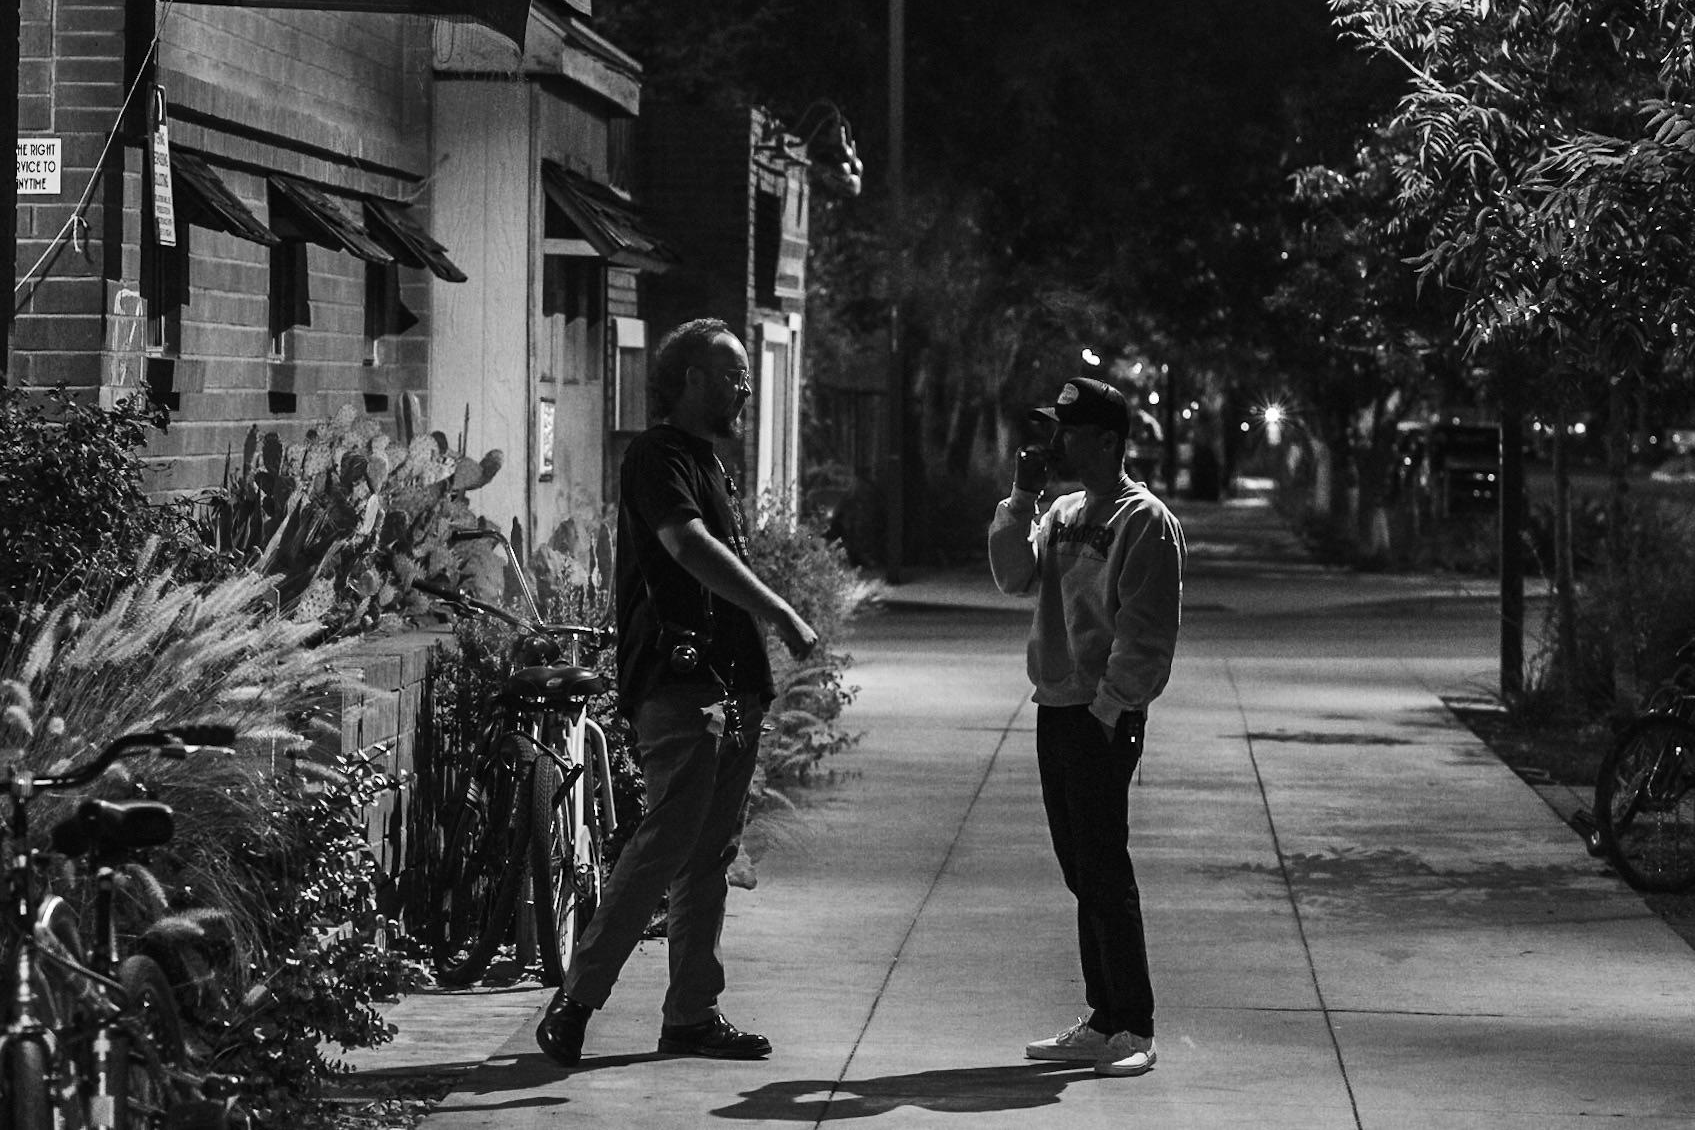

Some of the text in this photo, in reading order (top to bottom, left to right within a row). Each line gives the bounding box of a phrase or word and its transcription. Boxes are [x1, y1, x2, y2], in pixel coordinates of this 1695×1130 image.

[17, 144, 55, 156] HE RIGHT
[16, 161, 56, 173] RVICE TO
